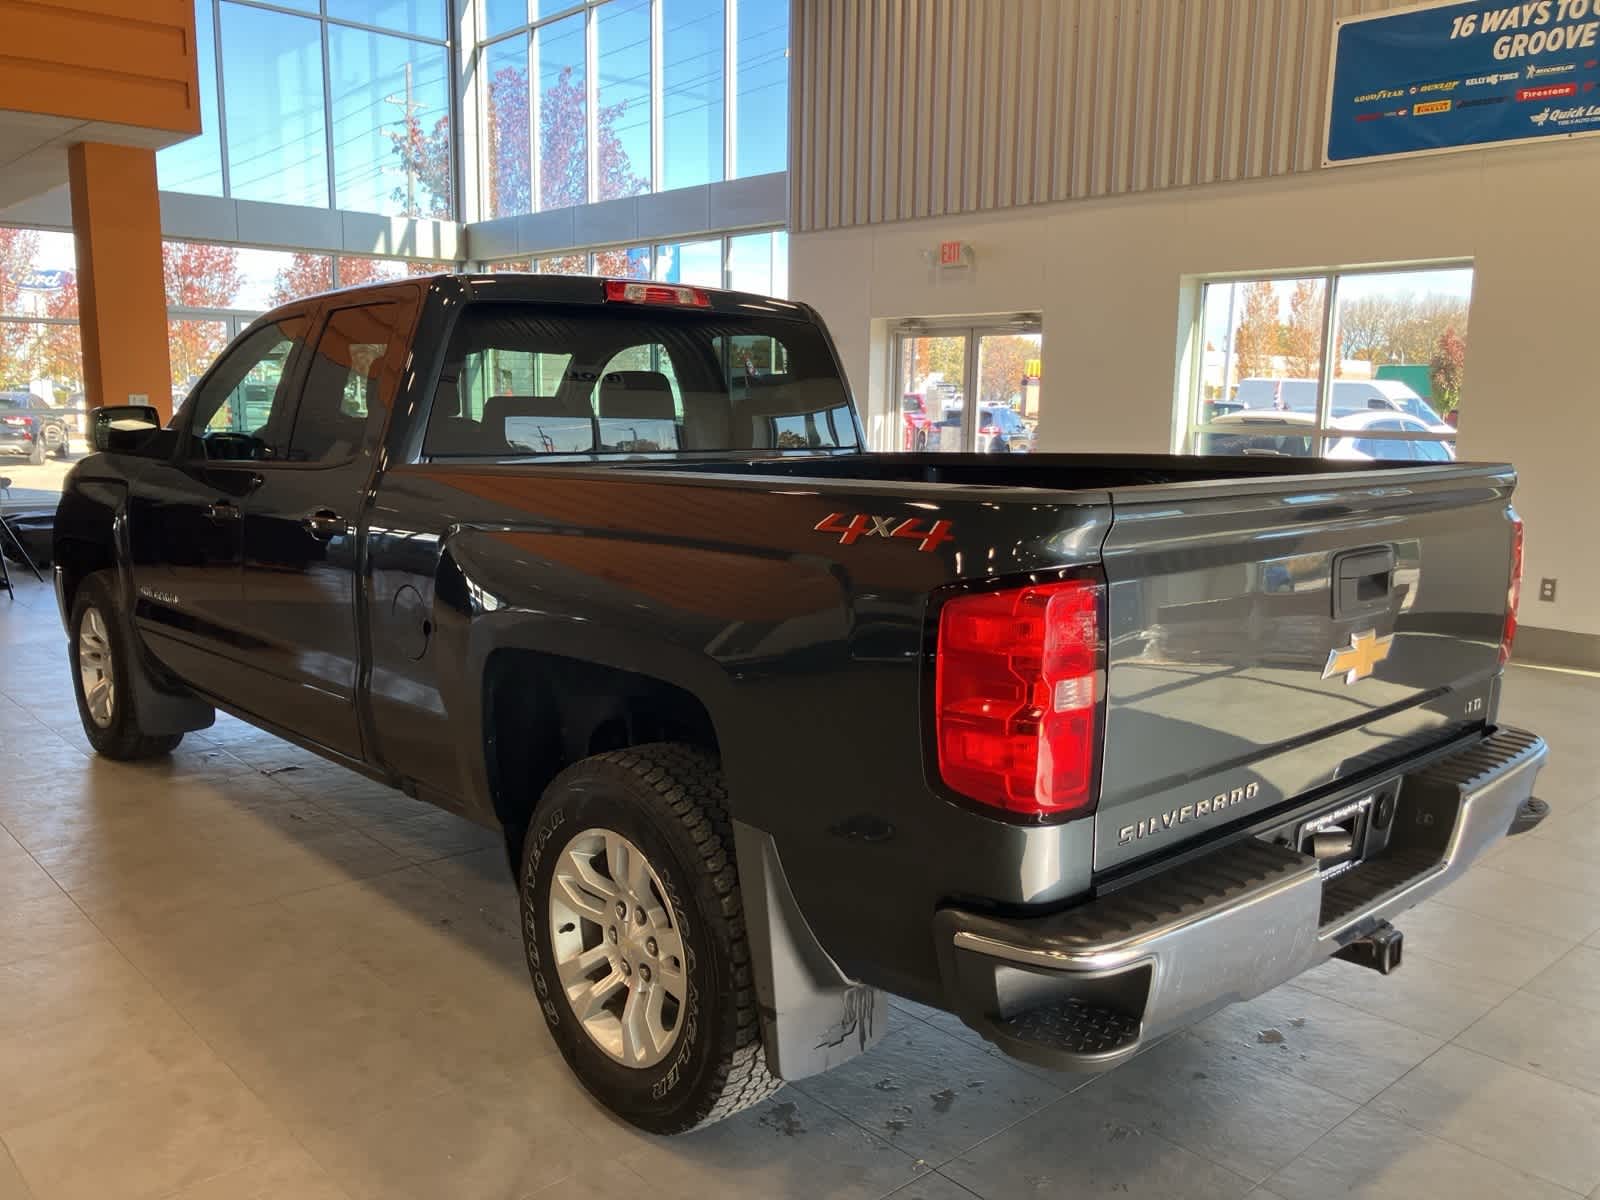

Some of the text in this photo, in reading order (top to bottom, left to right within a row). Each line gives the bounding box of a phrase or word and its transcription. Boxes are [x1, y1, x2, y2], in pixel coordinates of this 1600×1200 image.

[1450, 14, 1478, 39] 16
[1481, 1, 1551, 33] WAYS
[1556, 0, 1587, 22] TO
[1493, 22, 1599, 60] GROOVE
[1354, 90, 1404, 103] GOODYEAR
[1522, 87, 1571, 99] Firestone
[1548, 106, 1586, 121] Quick
[942, 243, 960, 264] EXIT
[1118, 782, 1260, 846] SILVERADO
